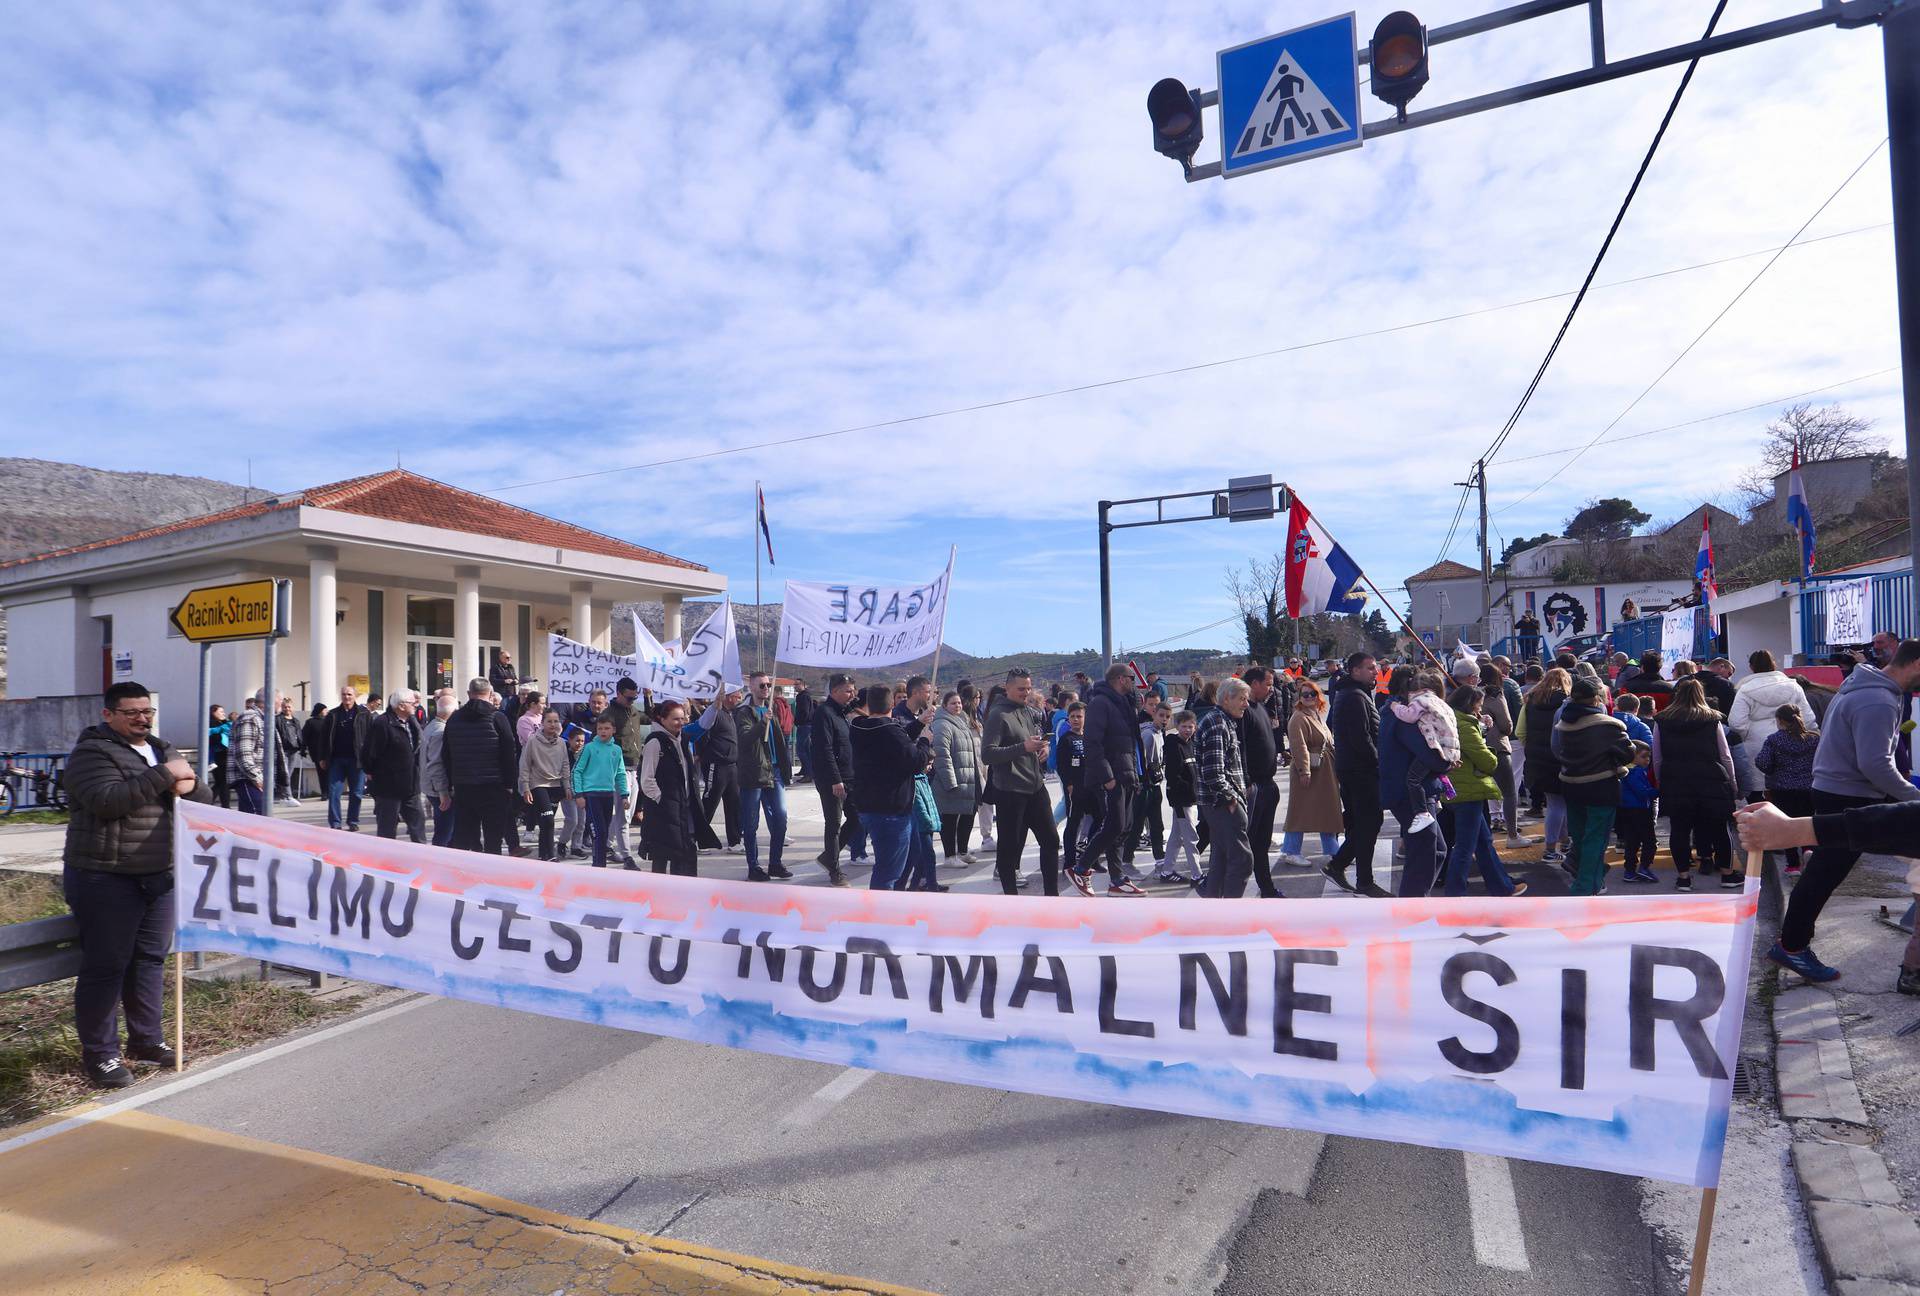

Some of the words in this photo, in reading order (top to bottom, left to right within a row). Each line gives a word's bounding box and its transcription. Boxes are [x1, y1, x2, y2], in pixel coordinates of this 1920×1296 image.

[187, 596, 269, 627] Račnik-Strane
[552, 661, 579, 675] KAD
[607, 667, 632, 678] ONO
[721, 928, 1339, 1061] NORMALNE
[1436, 931, 1729, 1090] ŠIR
